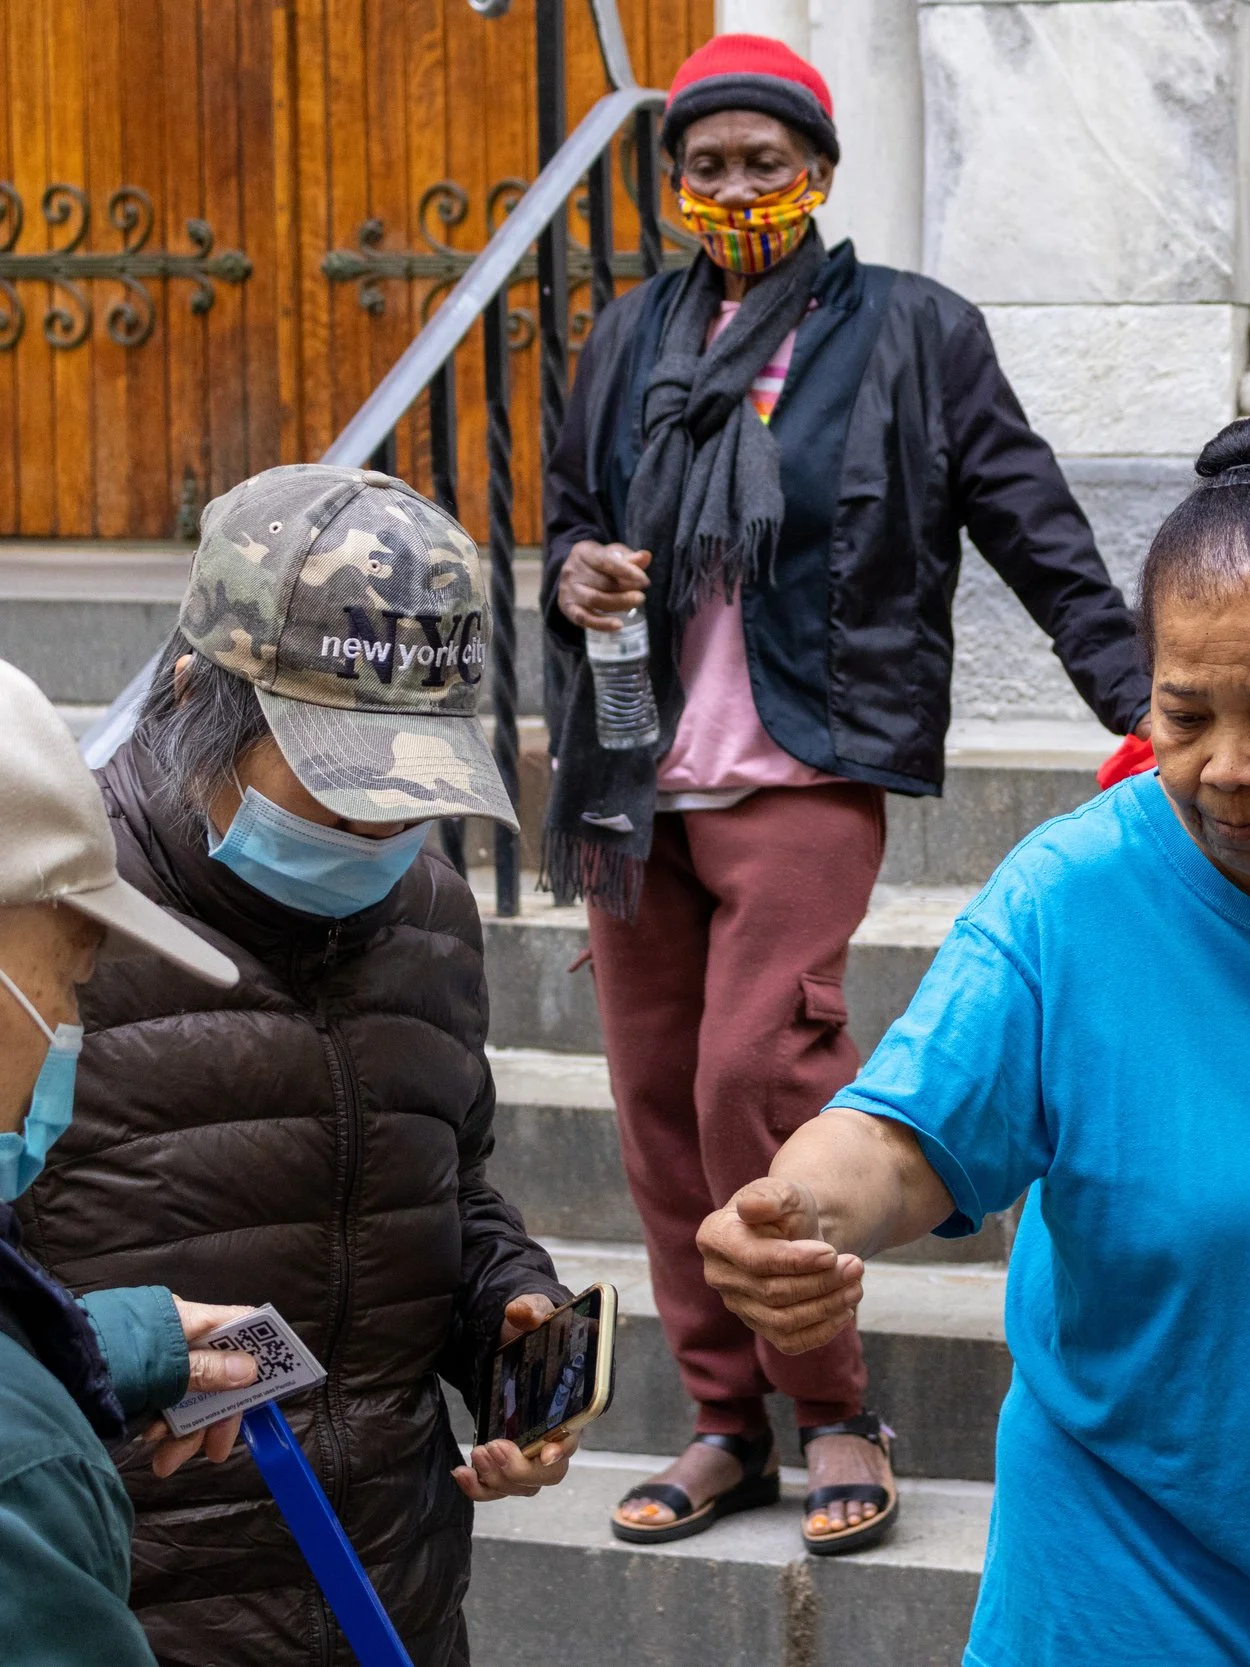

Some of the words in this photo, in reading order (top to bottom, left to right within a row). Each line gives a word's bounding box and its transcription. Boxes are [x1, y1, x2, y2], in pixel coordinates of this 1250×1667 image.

[320, 635, 392, 662] new
[398, 640, 459, 671] york
[462, 636, 487, 670] city
[336, 605, 482, 687] NYC
[180, 1422, 192, 1430] This
[191, 1417, 205, 1427] pass
[205, 1411, 221, 1420] works
[227, 1403, 237, 1412] any
[236, 1396, 253, 1407] pantry
[252, 1392, 263, 1401] that
[263, 1387, 275, 1396] uses
